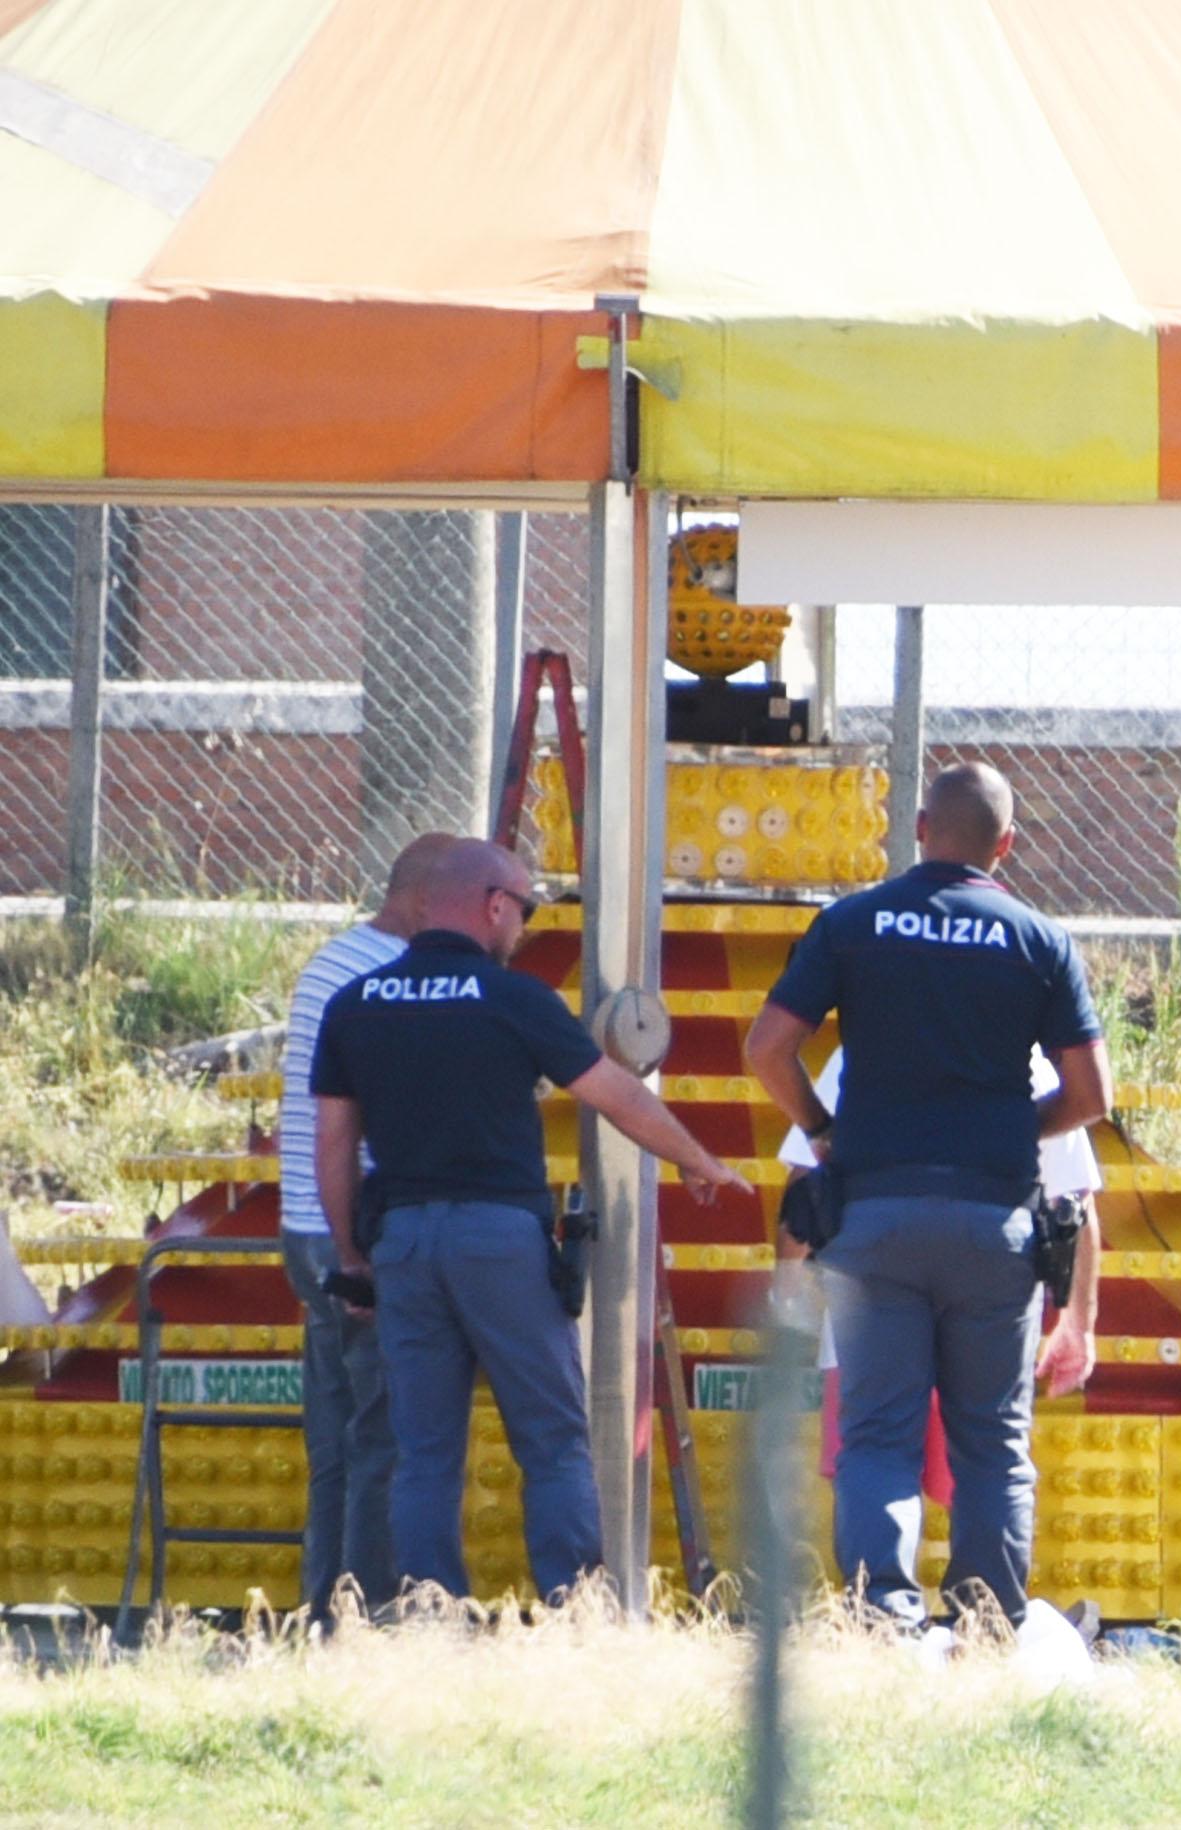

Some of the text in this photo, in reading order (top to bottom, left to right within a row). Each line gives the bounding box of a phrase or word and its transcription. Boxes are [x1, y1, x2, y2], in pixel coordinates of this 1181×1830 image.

[874, 910, 1008, 948] POLIZIA
[361, 975, 481, 1001] POLIZIA
[203, 1363, 304, 1403] SPORGERS
